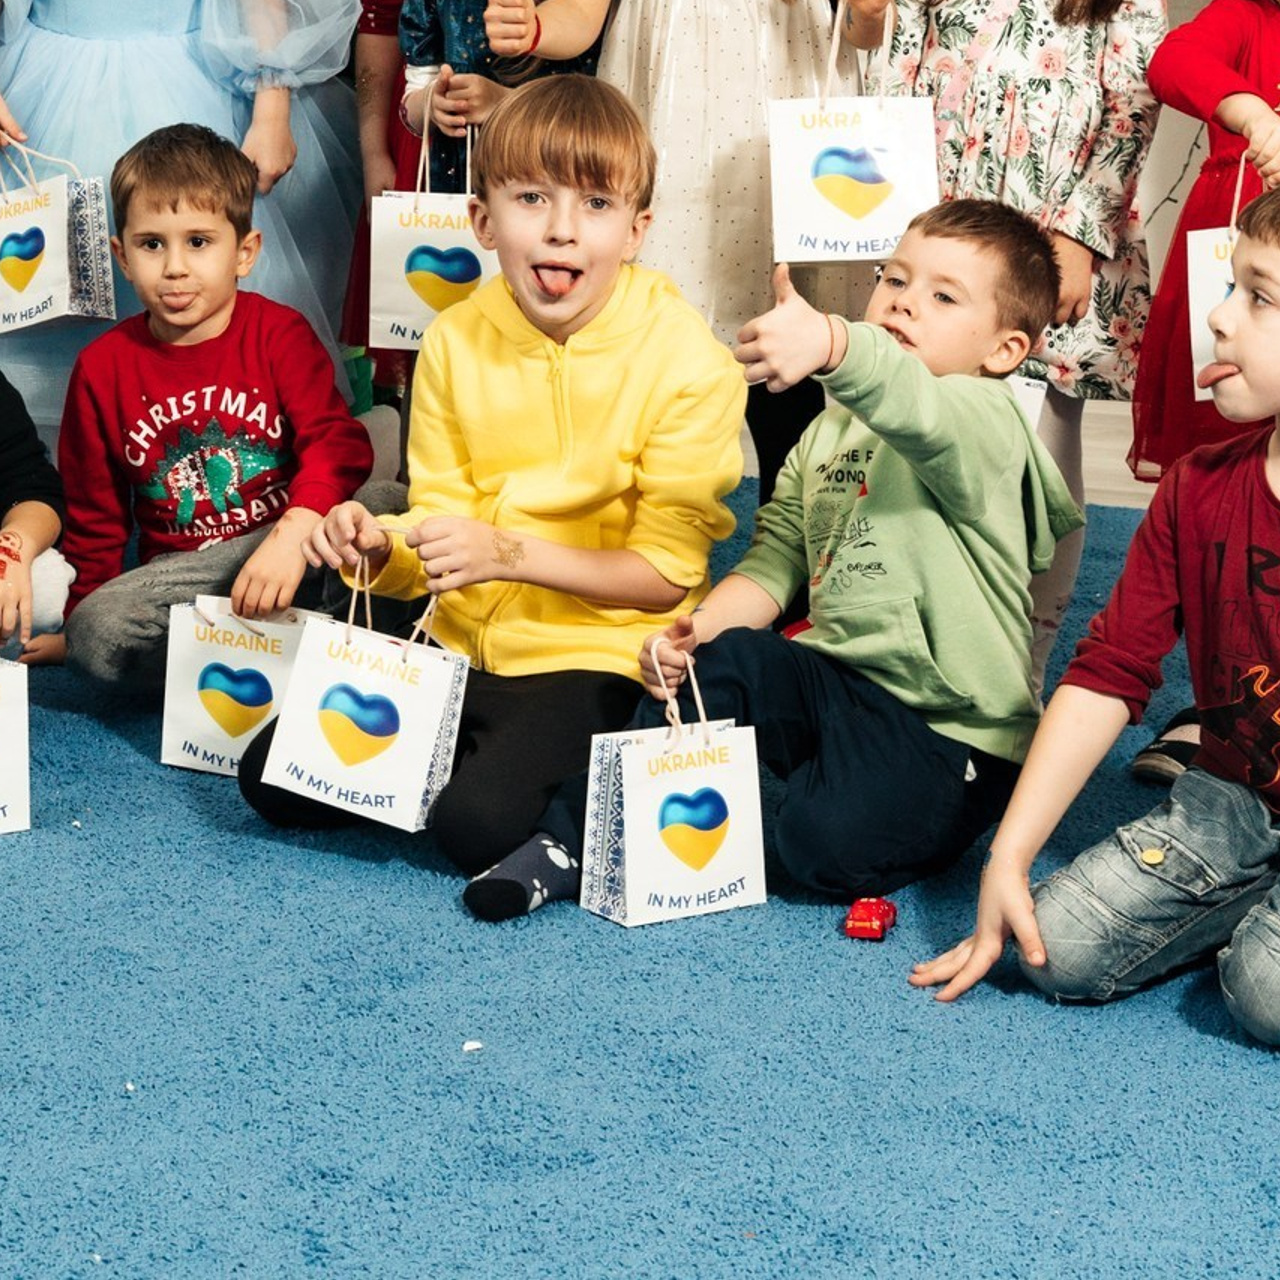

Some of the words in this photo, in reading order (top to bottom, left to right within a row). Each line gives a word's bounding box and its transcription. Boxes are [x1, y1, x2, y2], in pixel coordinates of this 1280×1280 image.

[398, 212, 472, 230] UKRAIN
[798, 234, 818, 249] IN
[822, 239, 851, 253] MY
[856, 235, 903, 253] HEA
[2, 311, 18, 325] MY
[20, 295, 54, 322] HEART
[389, 322, 407, 338] IN
[410, 329, 424, 341] M
[124, 385, 286, 467] CHRISTMAS
[194, 624, 283, 655] UKRAINE
[182, 740, 199, 757] IN
[202, 750, 226, 767] MY
[647, 746, 731, 777] UKRAINE
[286, 762, 305, 781] IN
[307, 774, 334, 795] MY
[336, 786, 396, 808] HEART
[647, 892, 664, 908] IN
[668, 893, 693, 909] MY
[696, 876, 746, 907] HEART
